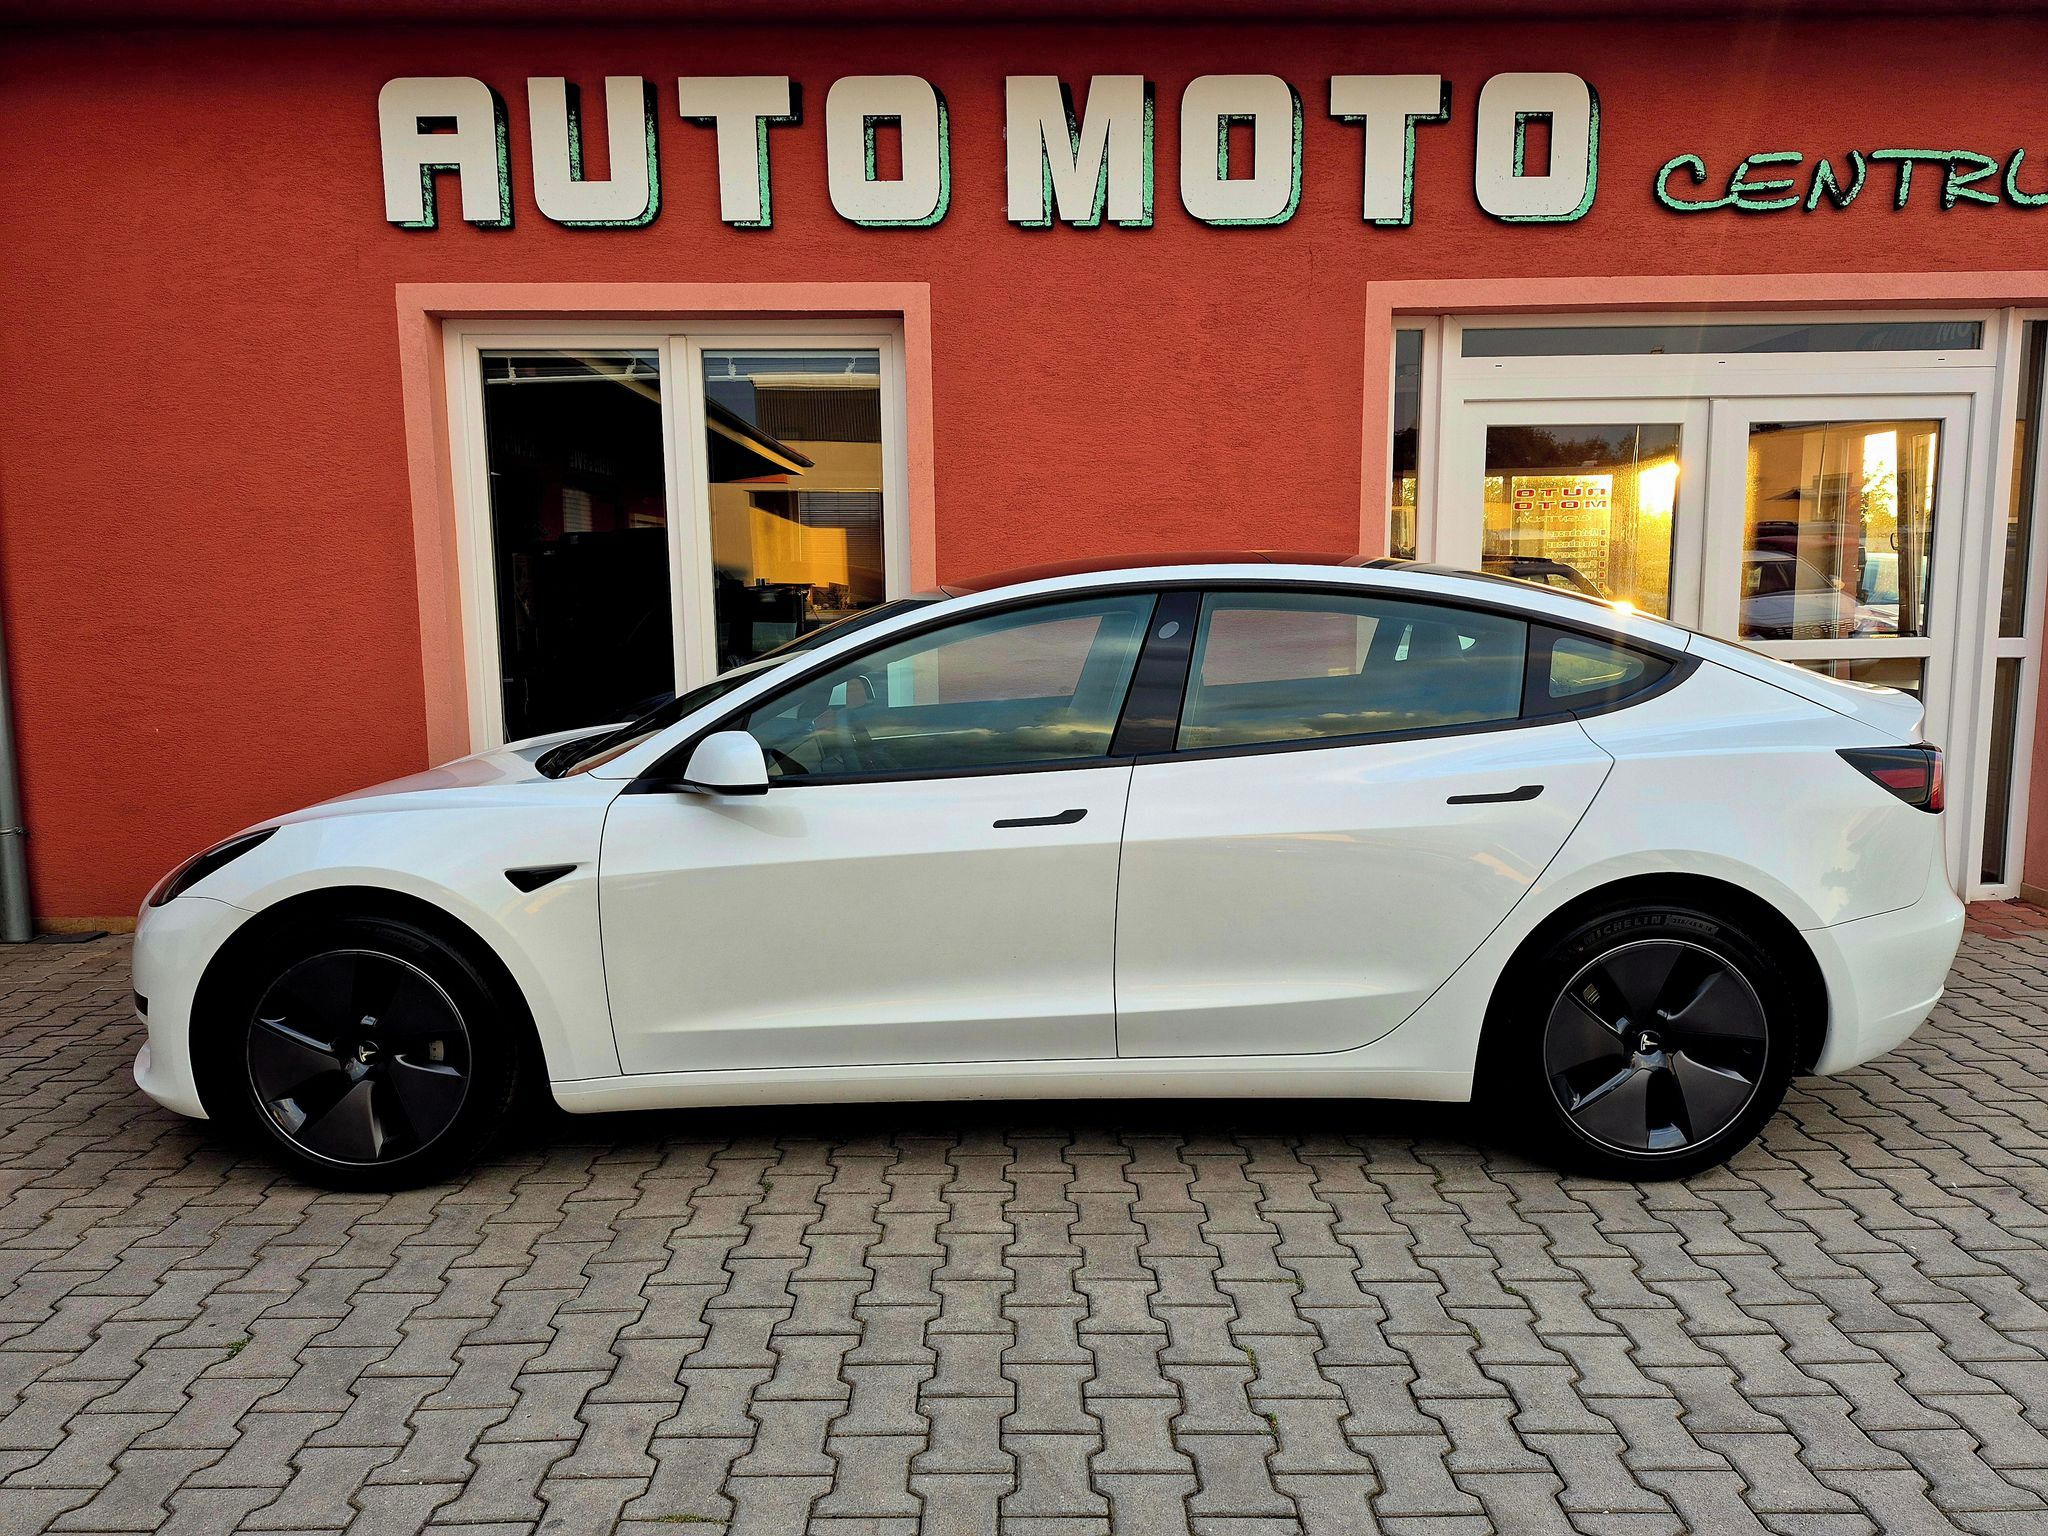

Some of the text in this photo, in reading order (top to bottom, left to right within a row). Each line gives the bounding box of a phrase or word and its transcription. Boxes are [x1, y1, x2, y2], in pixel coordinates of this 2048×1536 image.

[378, 76, 950, 229] AUTO
[1005, 72, 1599, 228] MOTO
[1584, 916, 1662, 944] MICHELIN
